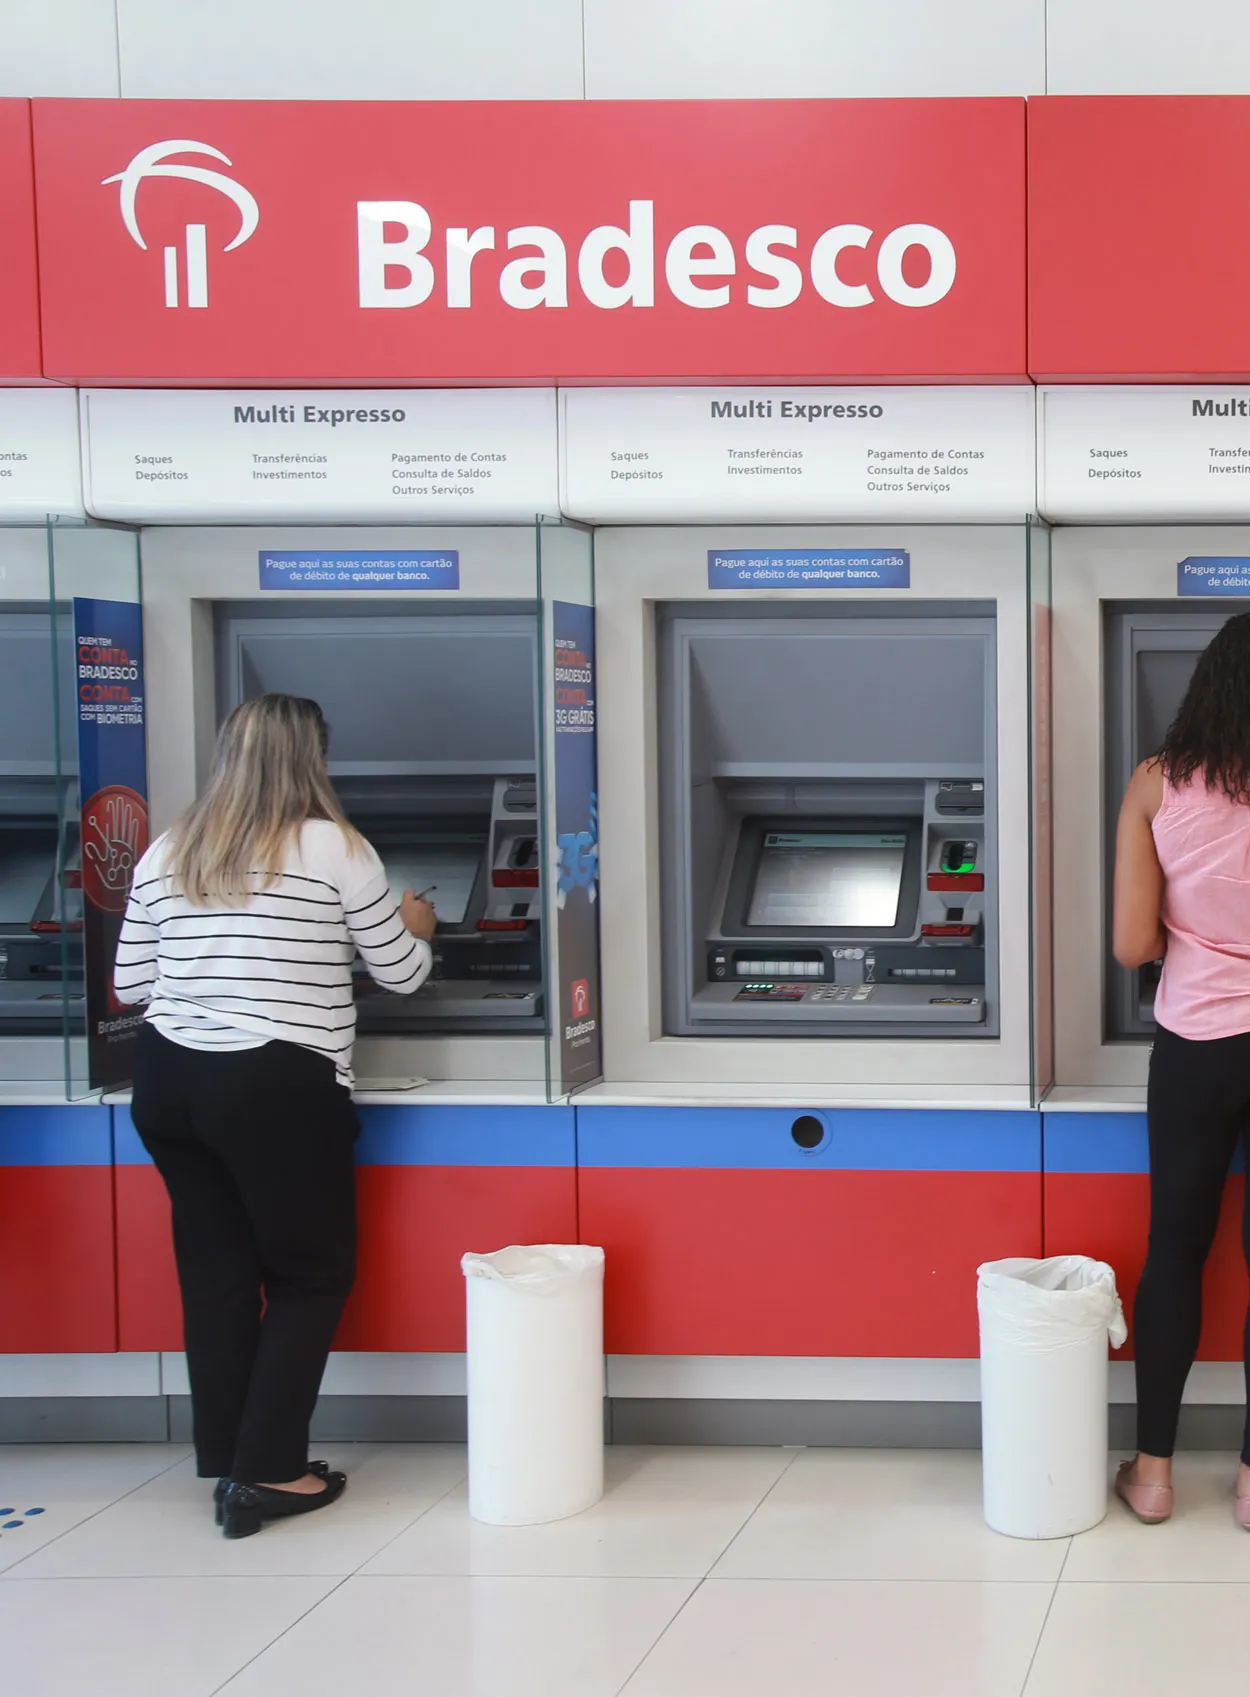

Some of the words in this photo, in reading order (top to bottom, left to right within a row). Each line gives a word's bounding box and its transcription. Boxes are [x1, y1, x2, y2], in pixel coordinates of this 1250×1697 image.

[358, 200, 956, 309] Bradesco
[233, 404, 295, 424] Multi
[303, 405, 406, 428] Expresso
[710, 399, 773, 418] Multi
[780, 400, 883, 423] Expresso
[0, 452, 28, 462] ontas
[251, 453, 328, 464] Transferências
[391, 452, 452, 465] Pagamento
[454, 452, 467, 462] de
[470, 452, 507, 462] Contas
[610, 451, 649, 463] Saques
[727, 448, 803, 459] Transferências
[867, 448, 928, 462] Pagamento
[931, 448, 945, 459] de
[947, 449, 985, 460] Contas
[1089, 448, 1128, 460] Saques
[134, 454, 173, 467] Saques
[252, 469, 327, 480] Investimentos
[392, 468, 438, 479] Consulta
[441, 468, 454, 479] de
[457, 467, 492, 478] Saldos
[610, 469, 663, 482] Depósitos
[727, 464, 802, 475] Investimentos
[867, 464, 914, 475] Consulta
[917, 465, 931, 476] de
[933, 464, 969, 476] Saldos
[1088, 467, 1142, 481] Depósitos
[135, 470, 188, 483] Depósitos
[392, 485, 428, 496] Outros
[431, 484, 475, 497] Serviços
[867, 481, 904, 492] Outros
[906, 481, 951, 494] Serviços
[265, 558, 297, 570] Pague
[298, 558, 321, 570] aqui
[322, 560, 334, 569] as
[336, 560, 360, 569] suas
[361, 559, 396, 569] contas
[397, 560, 418, 569] com
[418, 558, 453, 568] cartão
[715, 557, 746, 569] Pague
[748, 556, 769, 569] aqui
[771, 559, 784, 567] as
[785, 558, 809, 567] suas
[811, 557, 846, 567] contas
[848, 558, 869, 566] com
[871, 556, 904, 566] cartão
[291, 571, 302, 581] de
[305, 570, 334, 581] débito
[338, 570, 350, 581] de
[352, 570, 395, 583] qualquer
[396, 570, 431, 581] banco.
[738, 569, 751, 580] de
[753, 567, 785, 580] débito
[787, 568, 799, 579] de
[801, 568, 846, 581] qualquer
[846, 567, 881, 579] banco.
[1184, 564, 1216, 577] Pague
[1218, 564, 1240, 577] aqui
[1208, 576, 1220, 586] de
[78, 646, 130, 665] CONTA
[79, 666, 138, 681] BRADESCO
[80, 684, 131, 702] CONTA
[96, 713, 144, 725] BIOMETRIA
[556, 708, 567, 725] 3G
